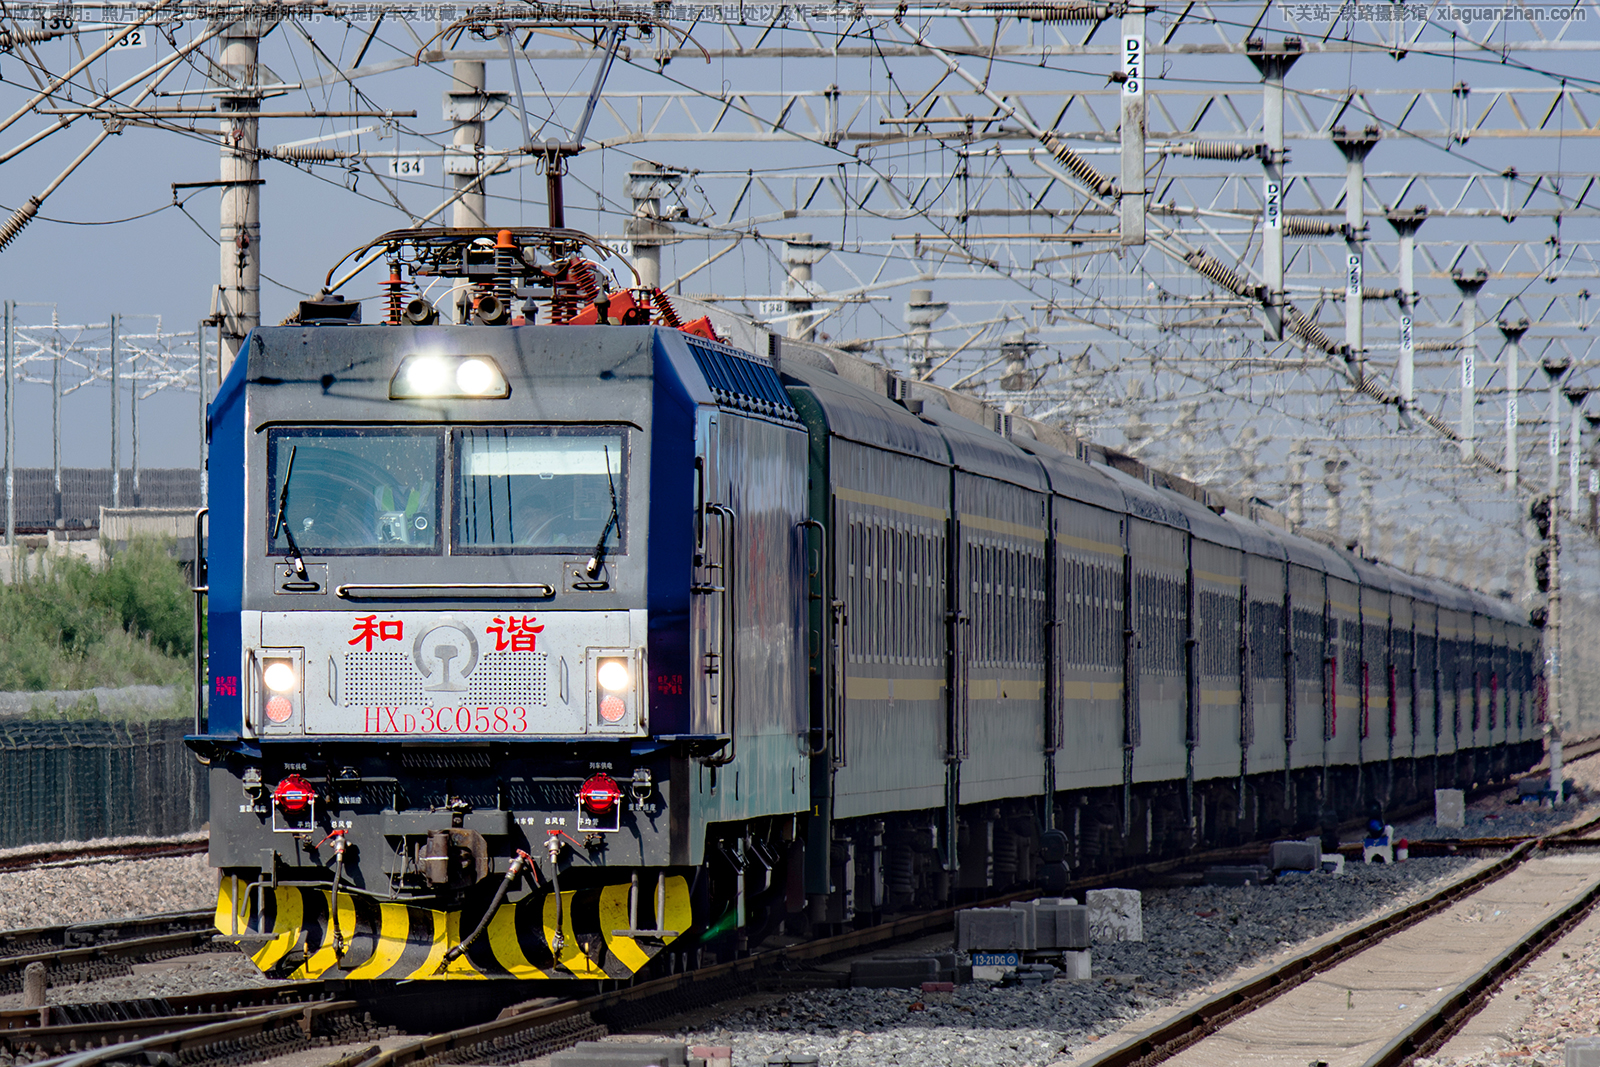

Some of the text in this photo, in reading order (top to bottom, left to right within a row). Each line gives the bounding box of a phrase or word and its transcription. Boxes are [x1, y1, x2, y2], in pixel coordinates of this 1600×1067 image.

[107, 31, 142, 48] 32
[1126, 39, 1140, 93] DZ49
[391, 159, 421, 174] 134
[1267, 183, 1279, 228] DZ51
[363, 705, 529, 734] HXD3C0583
[813, 804, 821, 817] 1
[974, 954, 1006, 966] 13-21DG
